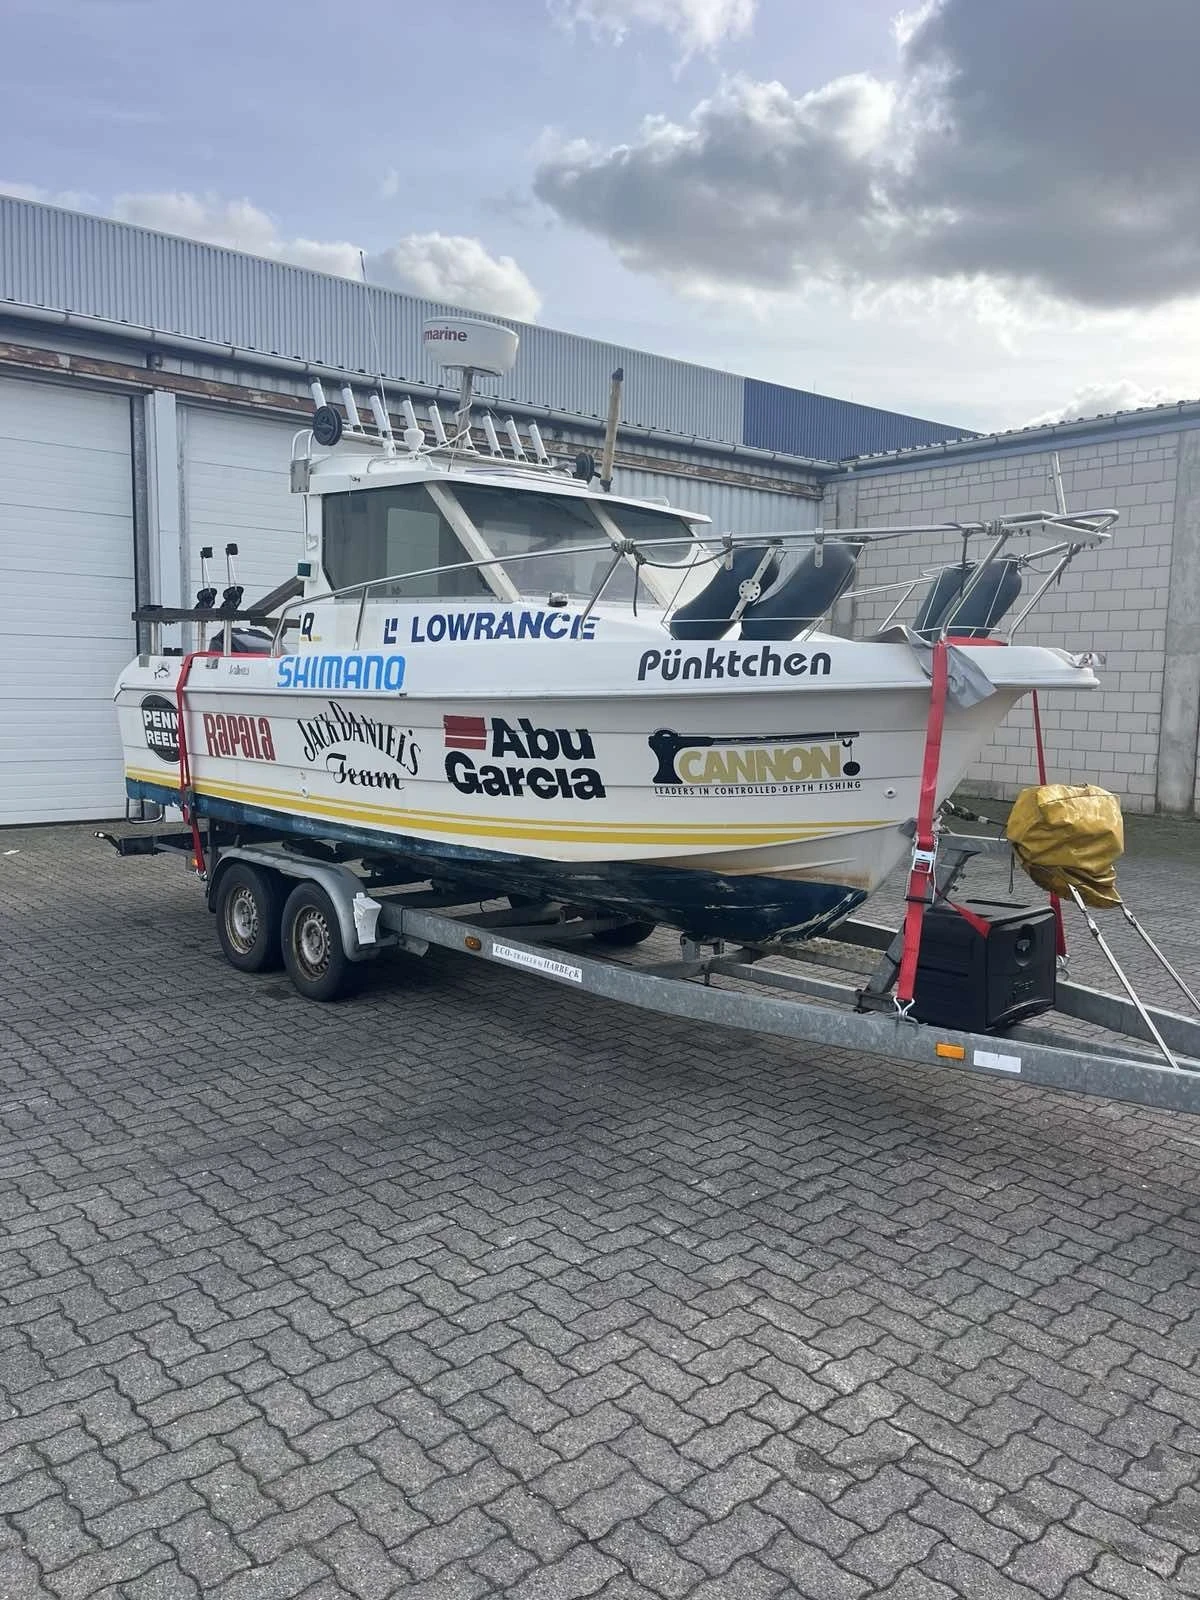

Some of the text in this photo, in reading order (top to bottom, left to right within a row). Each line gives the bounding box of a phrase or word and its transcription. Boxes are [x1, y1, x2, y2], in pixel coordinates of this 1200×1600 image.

[411, 611, 600, 643] LOWRANCE
[277, 655, 407, 691] SHIMANO
[638, 645, 832, 681] Pünktchen
[143, 710, 180, 730] PENN
[297, 700, 421, 776] JACK DANIEL'S
[491, 717, 596, 760] Abu
[326, 752, 405, 790] Team
[445, 750, 607, 800] Garcia
[678, 745, 841, 784] CANNON
[654, 786, 695, 796] LEADERS
[700, 786, 710, 796] IN
[819, 781, 862, 792] FISHING
[544, 960, 580, 978] HARBECK
